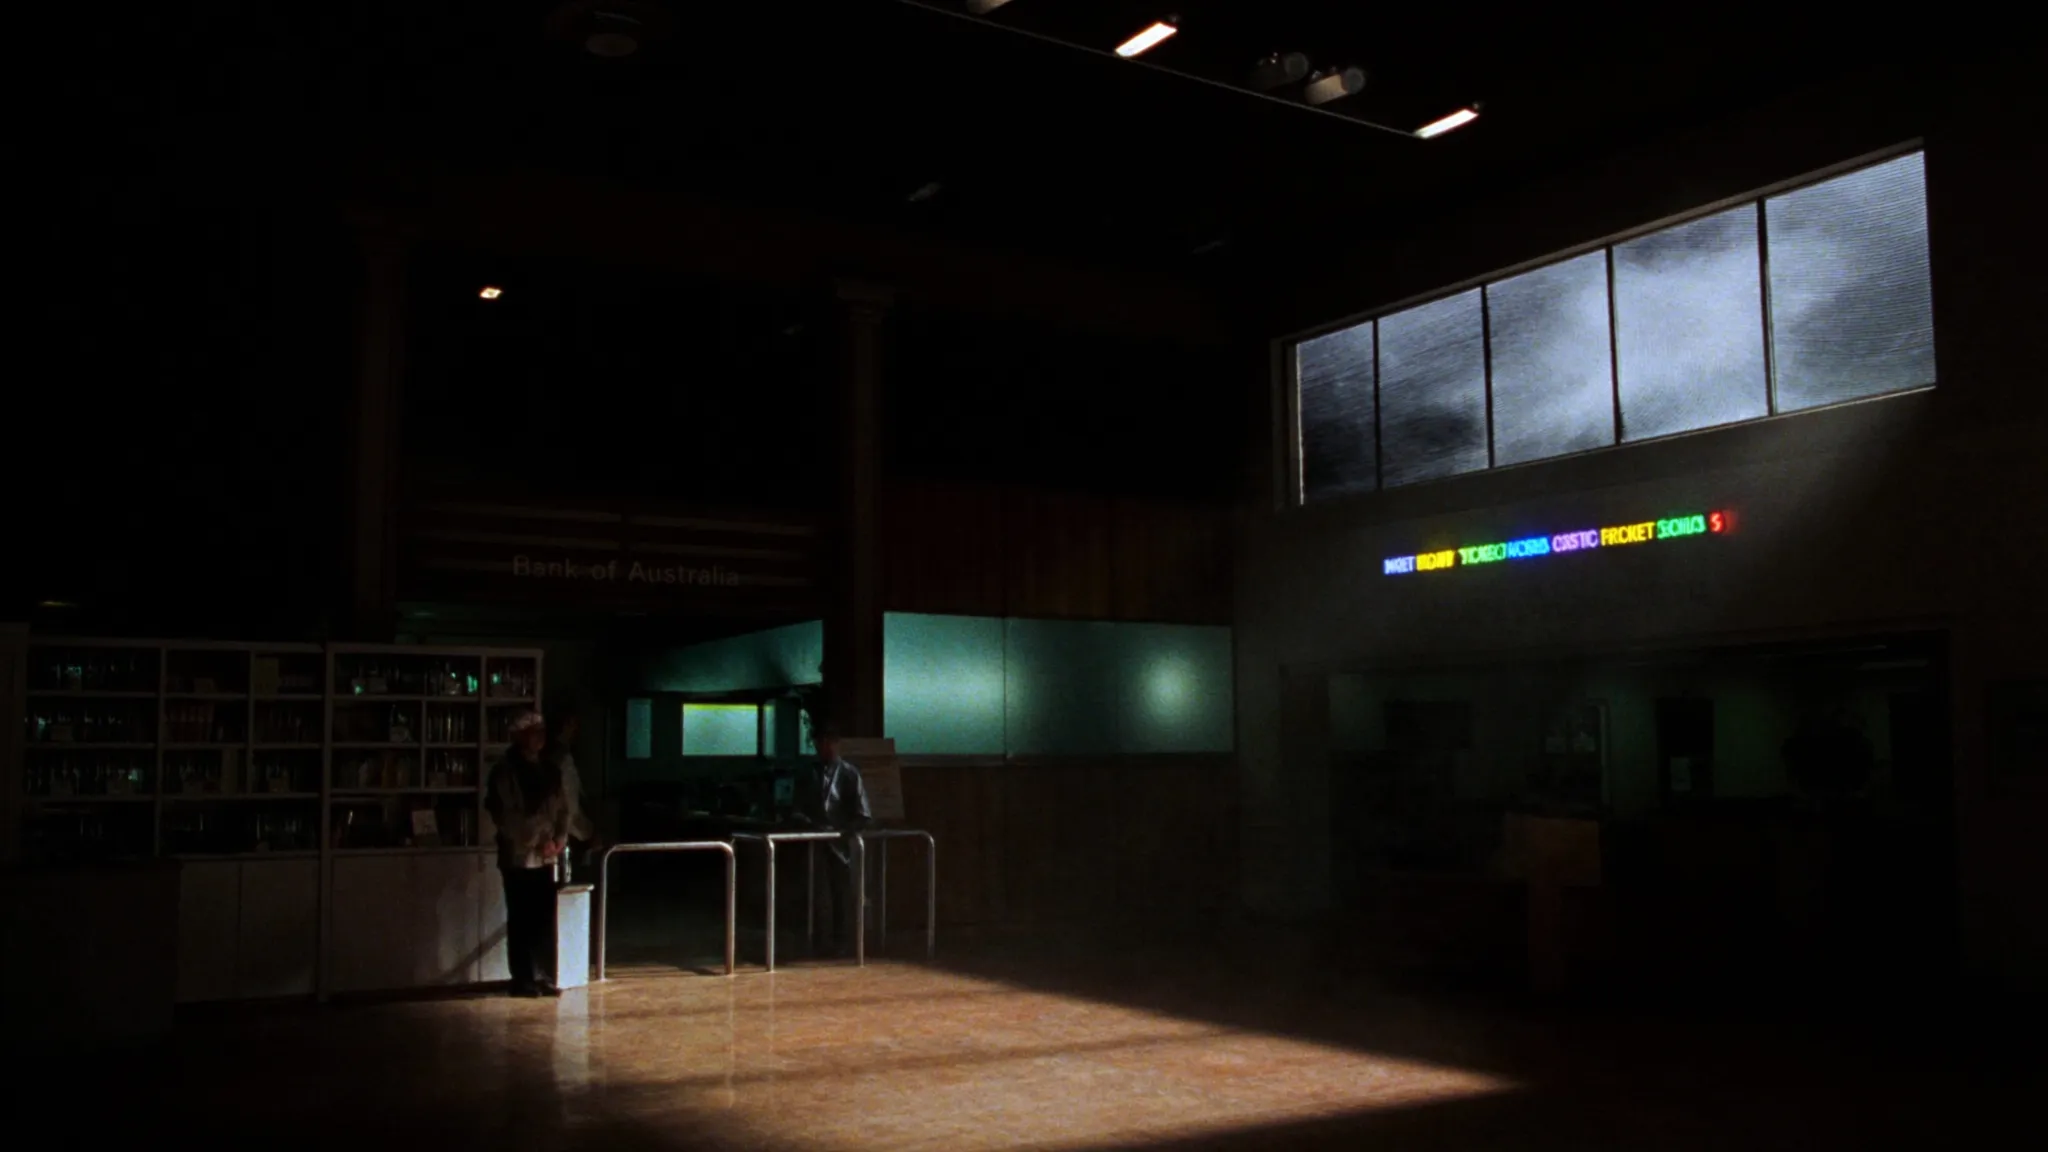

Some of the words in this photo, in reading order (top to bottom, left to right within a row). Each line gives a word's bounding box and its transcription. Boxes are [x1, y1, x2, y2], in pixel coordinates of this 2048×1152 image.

[512, 554, 578, 580] Bank
[591, 558, 618, 581] of
[628, 561, 741, 587] Australia
